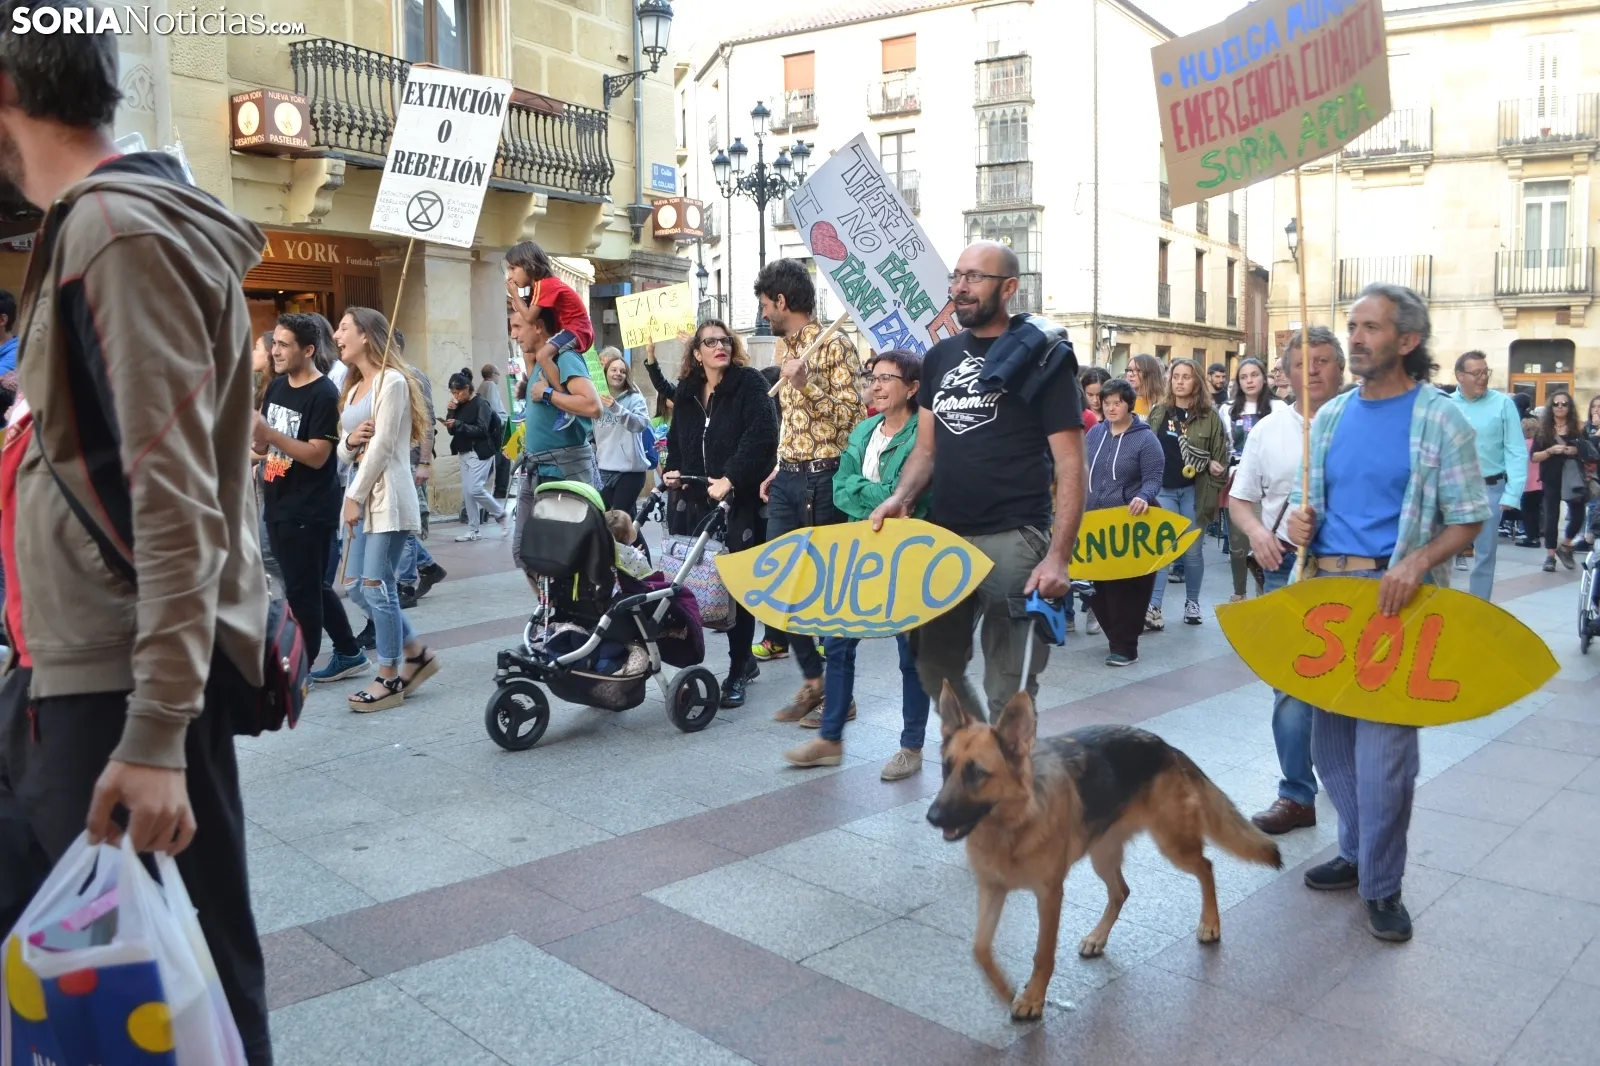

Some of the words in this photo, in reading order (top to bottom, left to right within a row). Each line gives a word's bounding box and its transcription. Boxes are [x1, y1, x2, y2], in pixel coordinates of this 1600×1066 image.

[1178, 17, 1281, 89] HUELGA
[233, 94, 250, 103] NUEVA
[249, 91, 263, 100] YORK
[268, 91, 290, 102] NUEVA
[290, 96, 306, 105] YORK
[403, 81, 506, 117] EXTINCIÓN
[234, 134, 265, 147] DESAYUNOS
[269, 133, 309, 148] PASTELERÍA
[437, 119, 453, 144] O
[390, 149, 487, 187] REBELIÓN
[1196, 128, 1287, 189] SORIA
[376, 204, 400, 216] SORIA
[841, 143, 914, 244] THERE
[896, 230, 926, 261] IS
[283, 239, 341, 265] YORK
[345, 256, 373, 267] Fundada
[837, 205, 882, 254] NO
[874, 250, 939, 323] PLANET
[829, 251, 888, 322] PLANET
[1292, 601, 1460, 702] SOL
